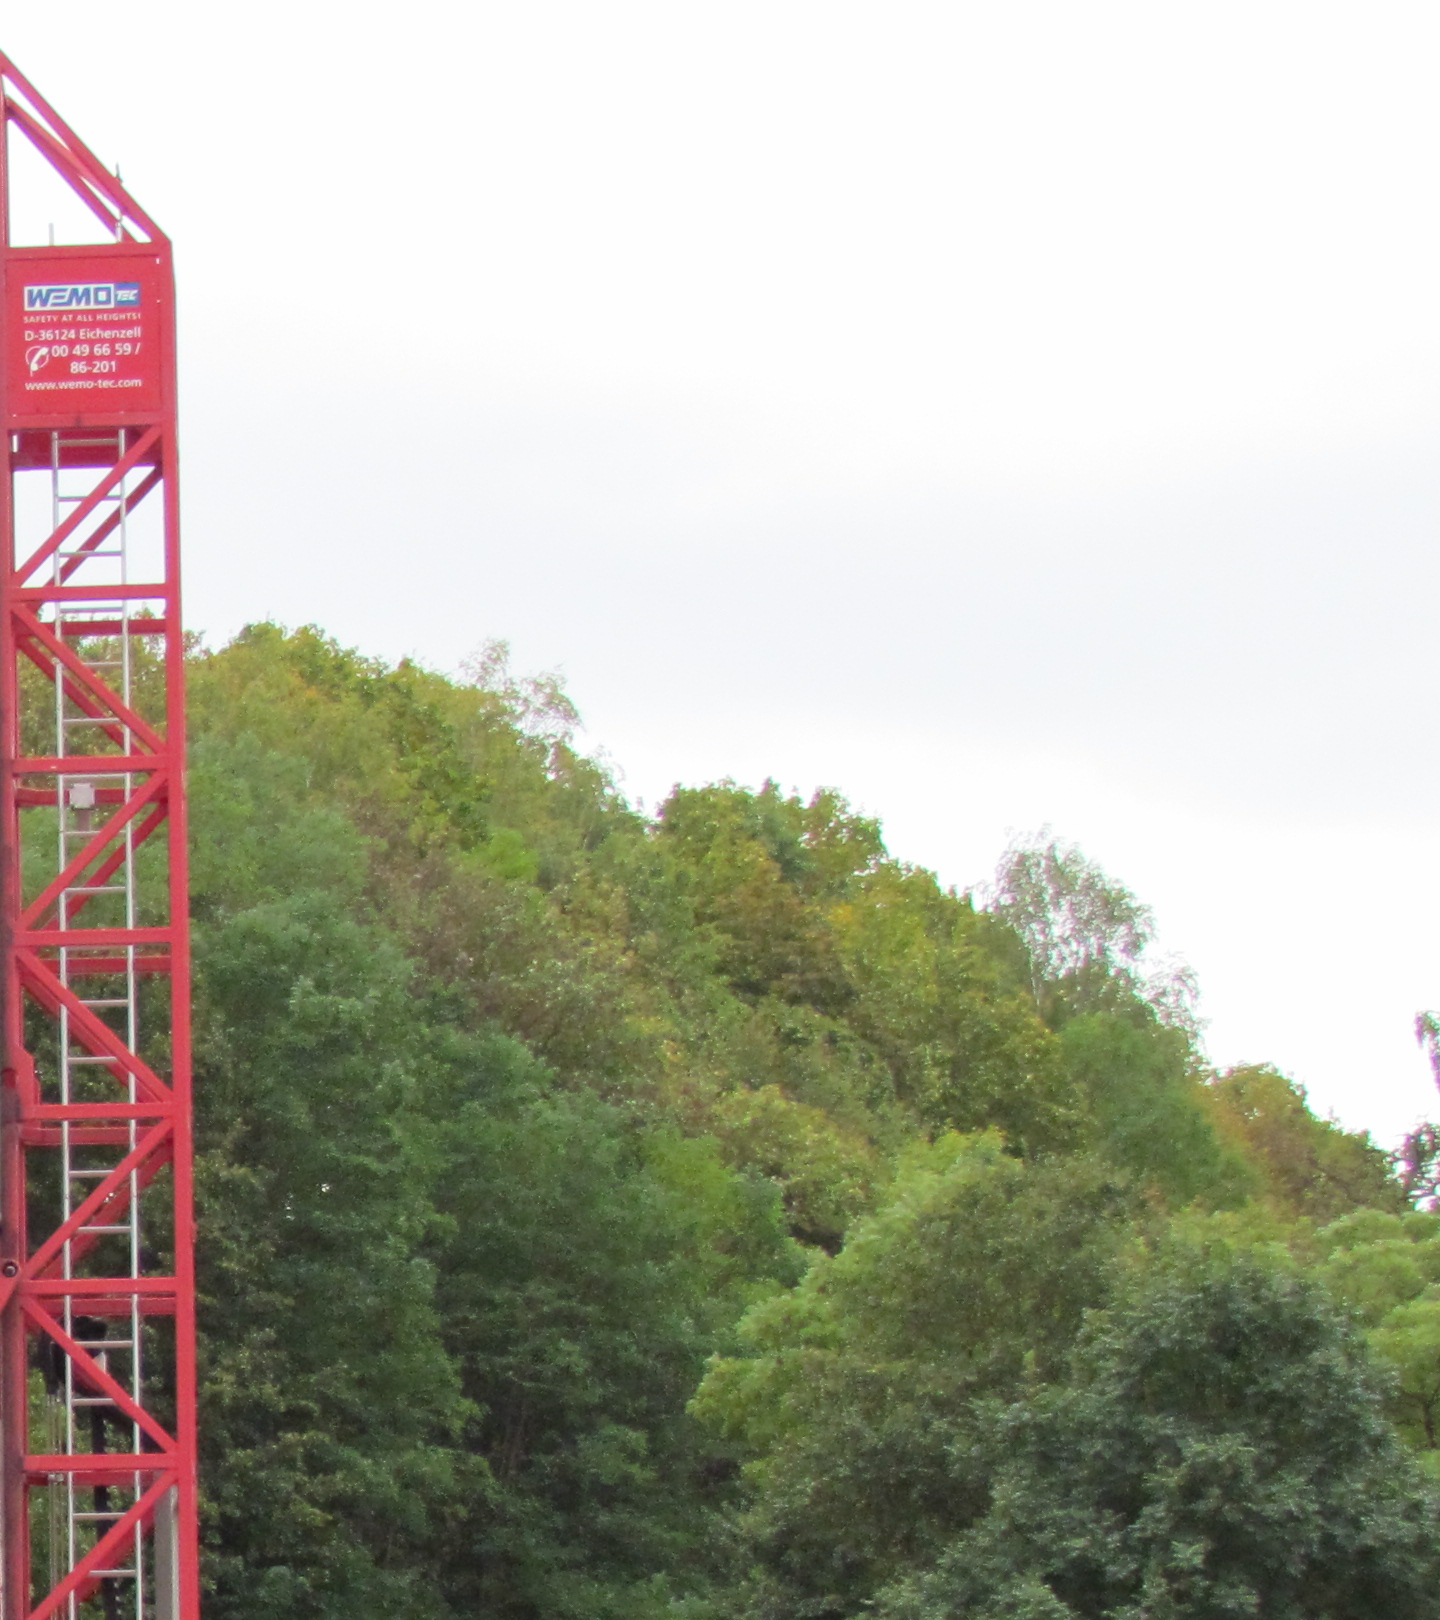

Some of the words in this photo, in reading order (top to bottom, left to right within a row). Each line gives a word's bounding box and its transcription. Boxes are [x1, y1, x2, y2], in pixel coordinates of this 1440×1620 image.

[26, 286, 113, 309] WEMO
[115, 289, 139, 302] TEC
[23, 314, 59, 323] SAFETY
[61, 314, 74, 322] AT
[76, 314, 94, 322] ALL
[24, 328, 76, 341] D-36124
[79, 326, 141, 340] Eichenzell
[51, 344, 69, 357] 00
[72, 344, 90, 357] 49
[93, 343, 111, 356] 66
[115, 342, 132, 356] 59
[134, 342, 141, 355] /
[70, 360, 117, 374] 86-201
[24, 378, 142, 391] www.wemo-tec.com
